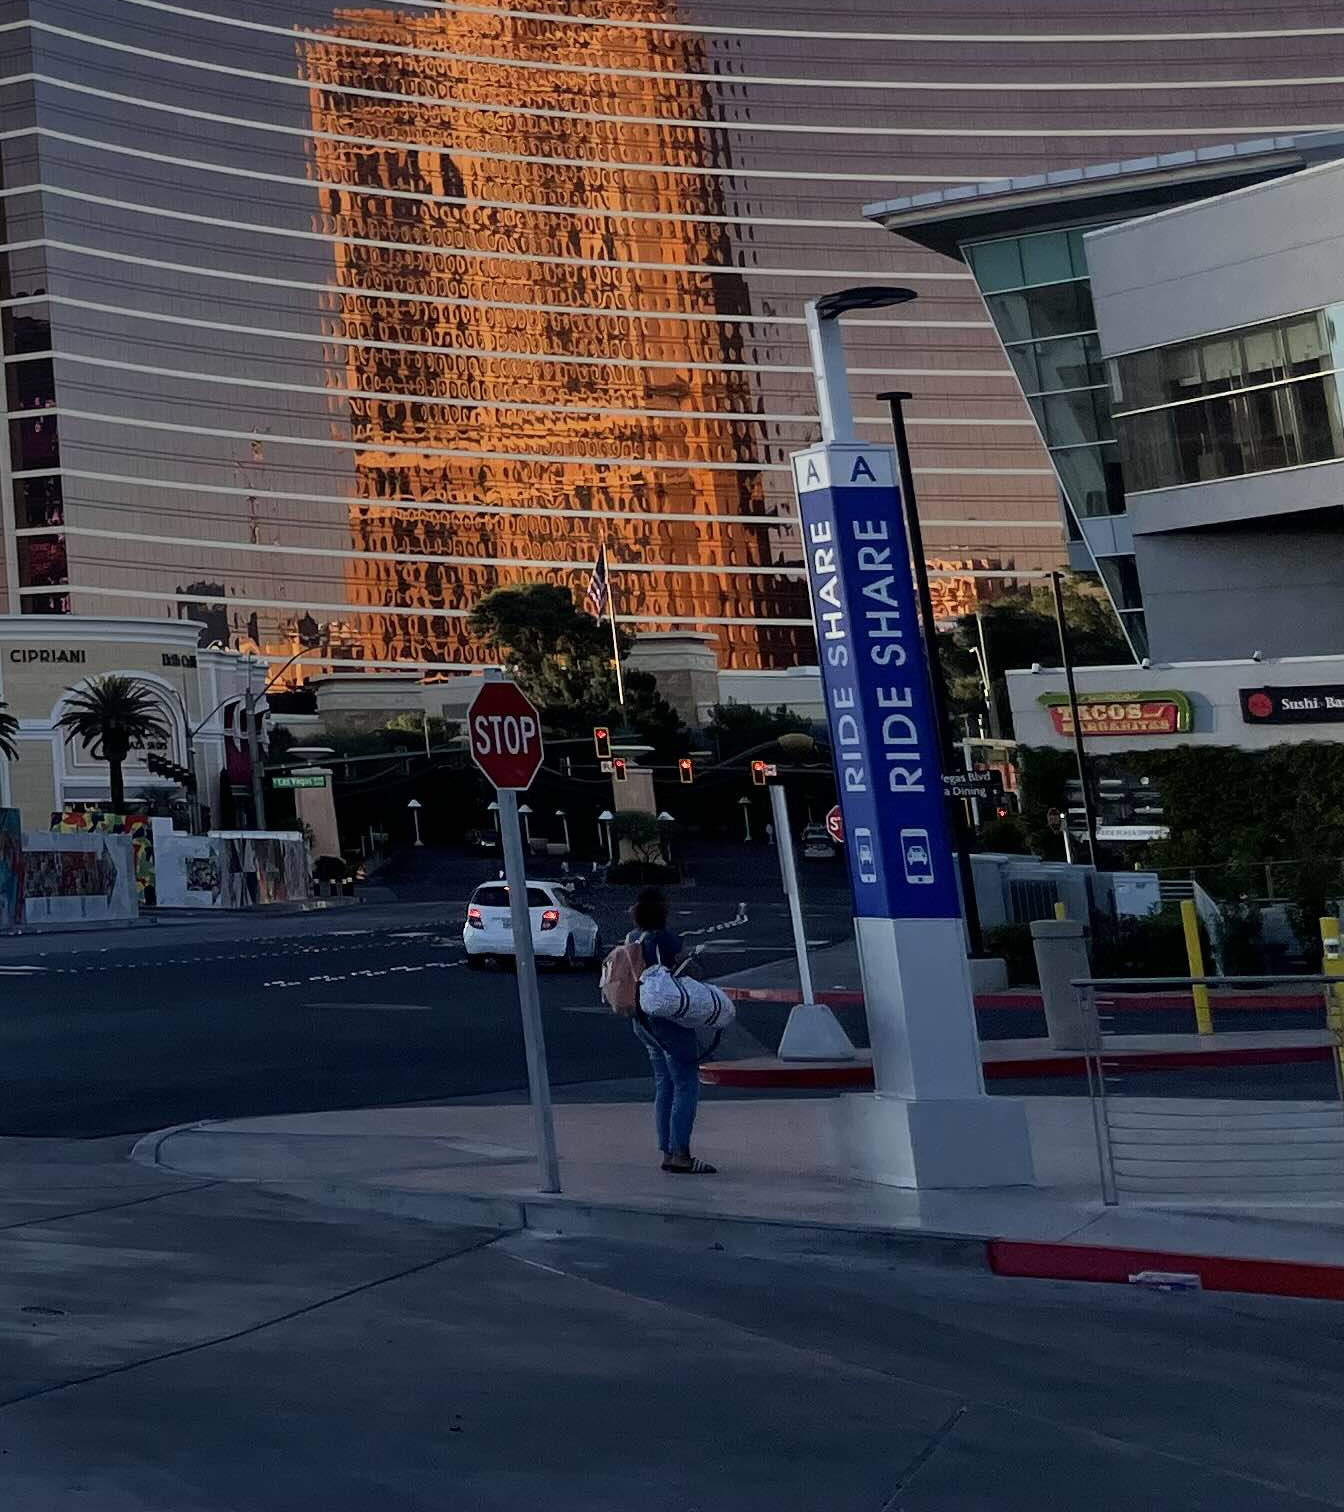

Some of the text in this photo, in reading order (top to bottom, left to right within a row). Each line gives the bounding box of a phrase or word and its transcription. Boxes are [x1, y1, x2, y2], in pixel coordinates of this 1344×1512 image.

[806, 457, 821, 486] A
[850, 455, 877, 482] A
[10, 649, 86, 664] CIPRIANI
[810, 520, 867, 792] RIDE SHARE
[852, 520, 925, 792] RIDE SHARE
[1057, 704, 1142, 721] TACOS
[1281, 696, 1344, 710] Sushi Ba
[475, 715, 535, 755] STOP
[941, 771, 991, 785] egas Blvd
[952, 786, 988, 798] Dining
